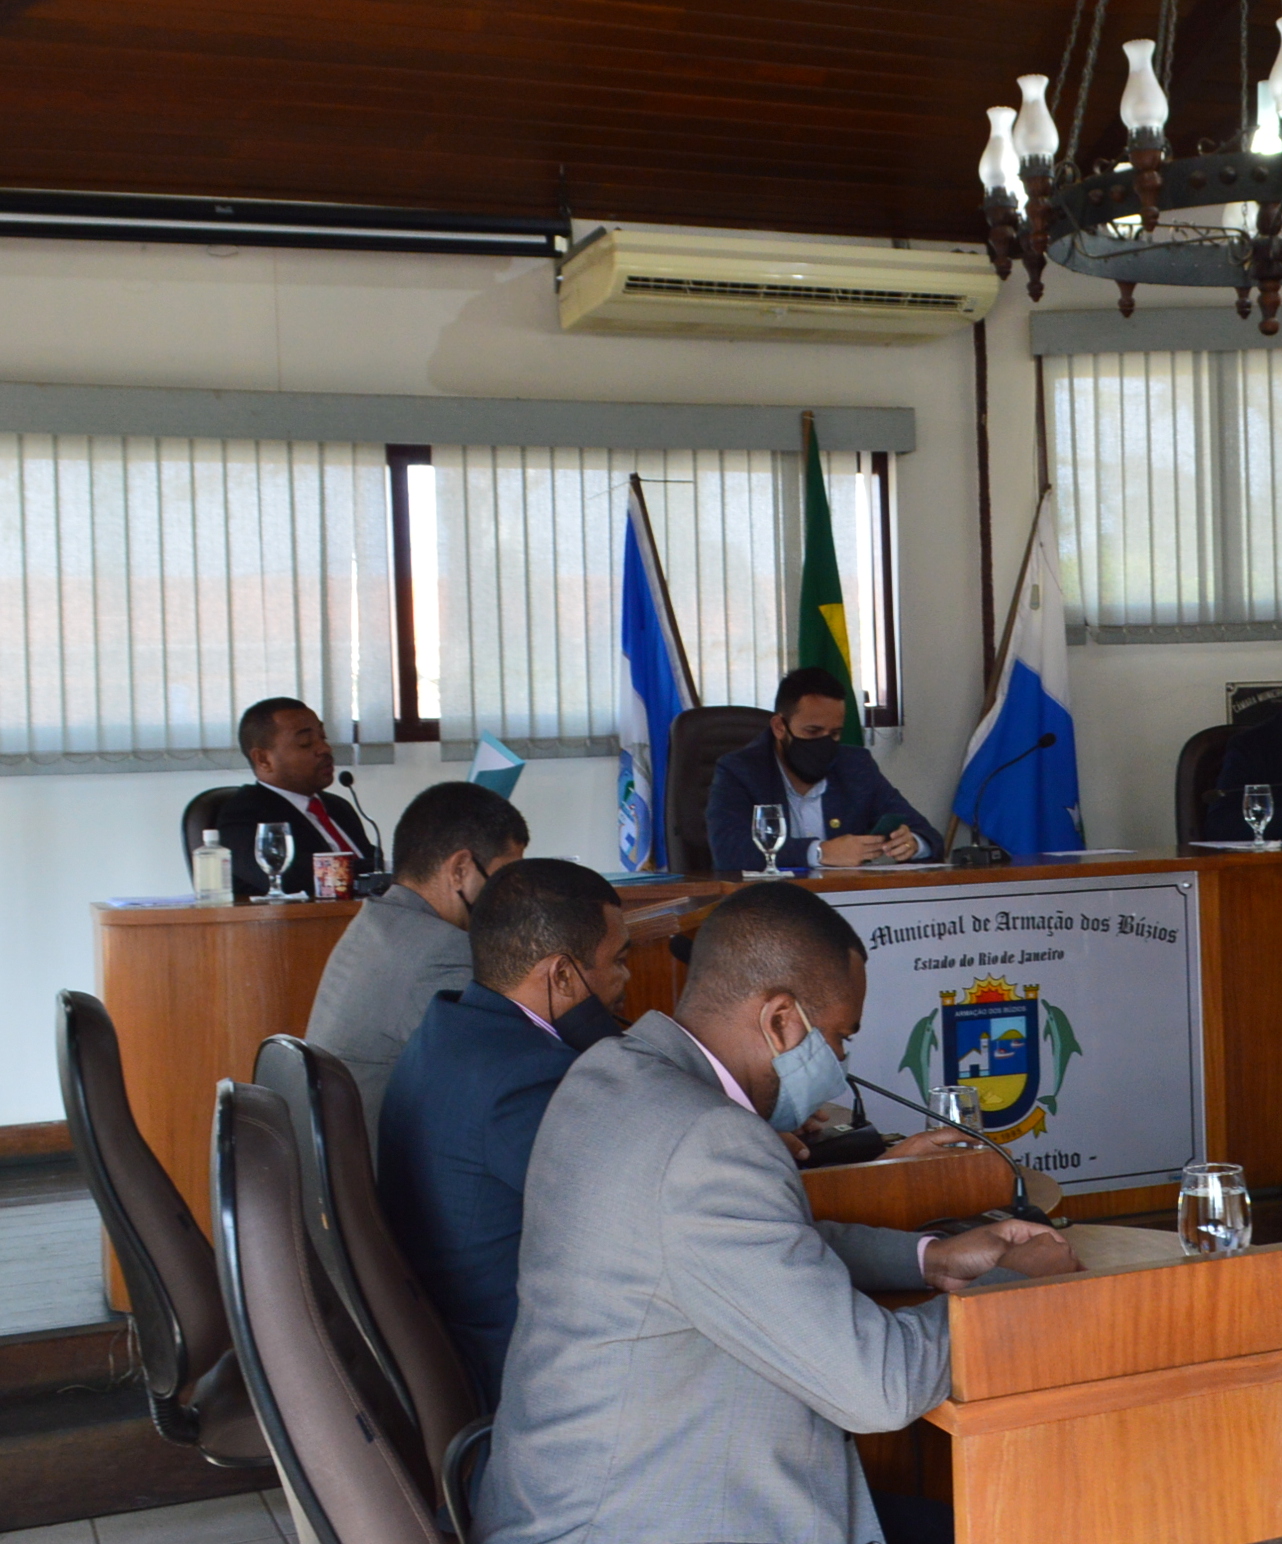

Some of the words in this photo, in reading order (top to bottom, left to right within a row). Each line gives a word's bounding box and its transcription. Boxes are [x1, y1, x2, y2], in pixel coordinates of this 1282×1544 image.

[869, 915, 965, 950] Municipal
[971, 914, 991, 933] de
[995, 911, 1074, 937] Armação
[1080, 913, 1111, 933] dos
[1116, 914, 1179, 944] Búzios
[913, 955, 956, 971] Estado
[959, 954, 974, 967] do
[978, 952, 998, 966] Rio
[1000, 950, 1015, 964] de
[1018, 948, 1065, 965] Janeiro
[1013, 1149, 1081, 1172] lativo
